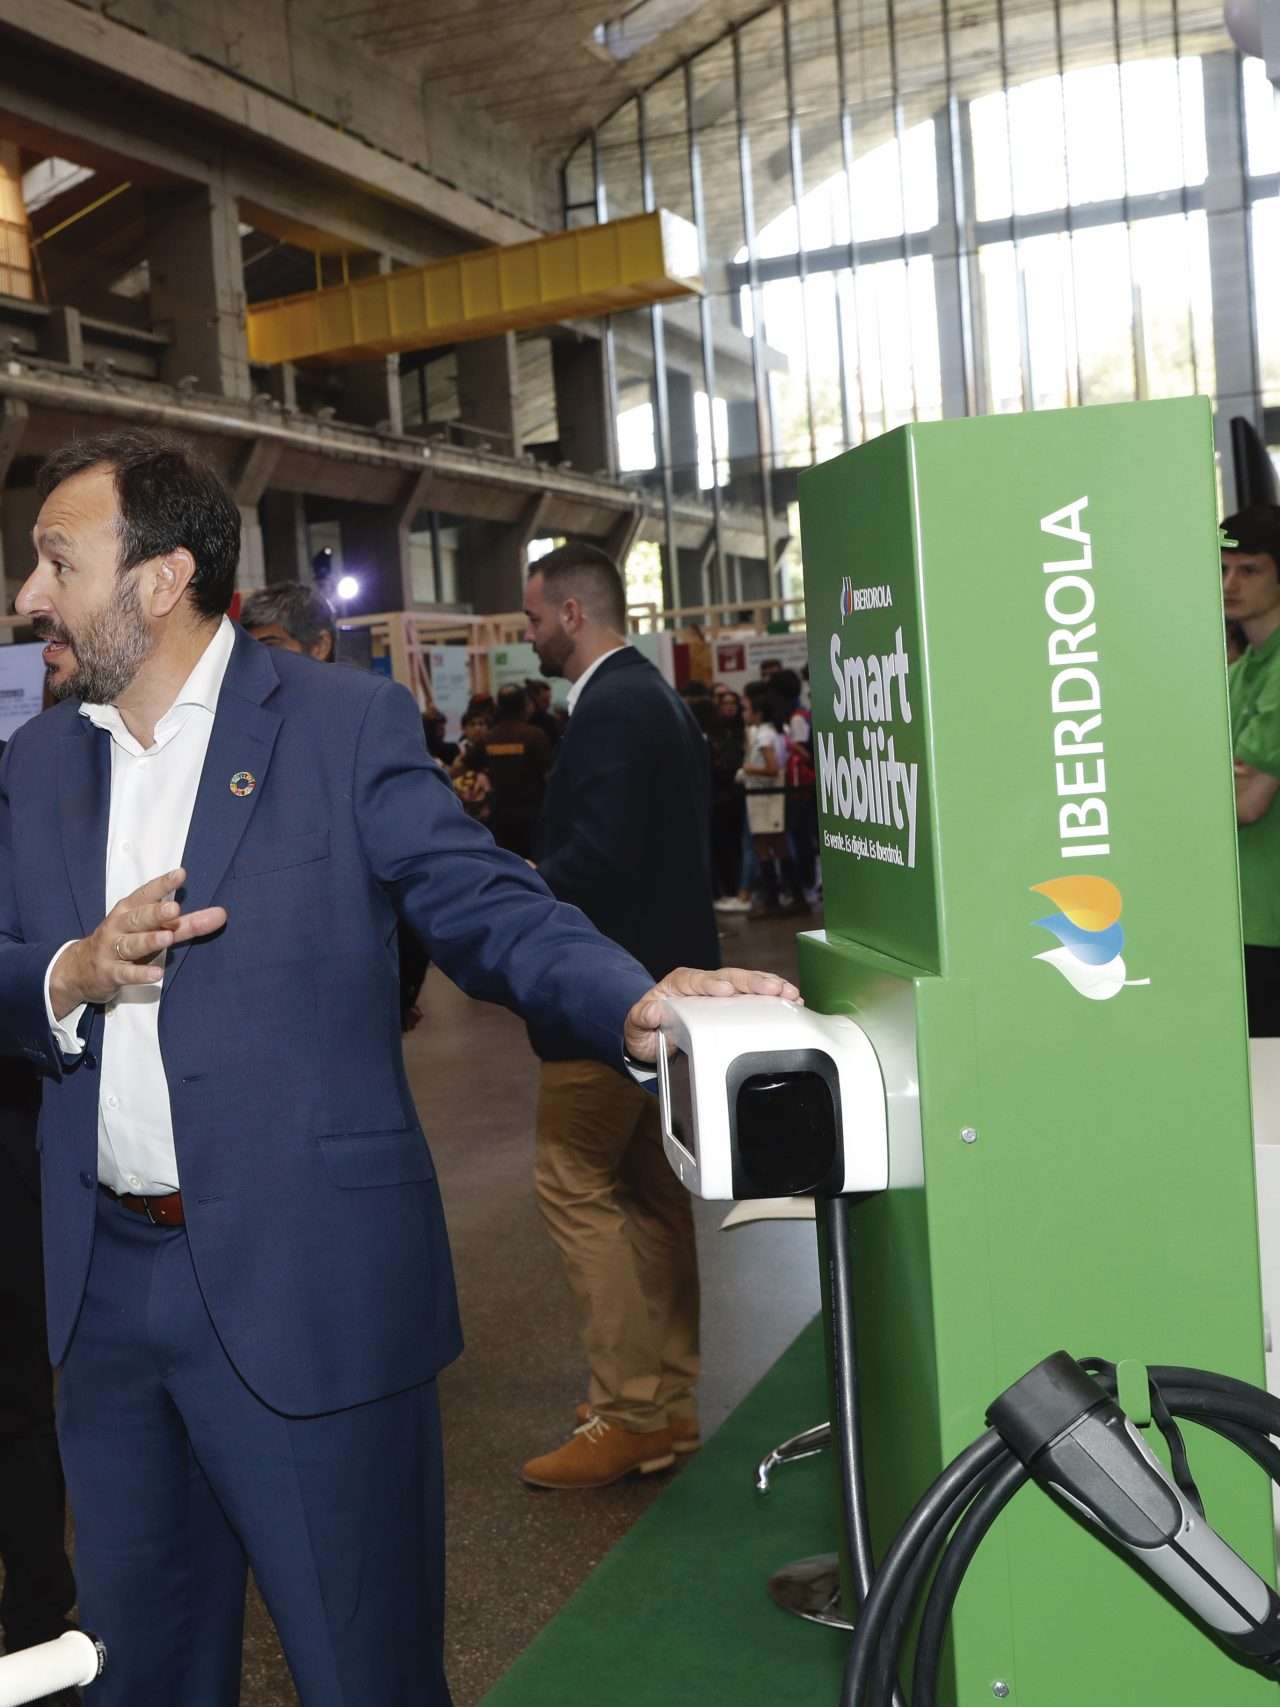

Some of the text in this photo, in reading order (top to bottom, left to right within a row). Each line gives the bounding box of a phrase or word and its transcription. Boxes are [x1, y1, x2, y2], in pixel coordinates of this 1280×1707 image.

[853, 585, 893, 611] IBERDROLA
[830, 625, 912, 723] Smart
[1040, 495, 1110, 857] IBERDROLA
[818, 726, 917, 868] Mobility
